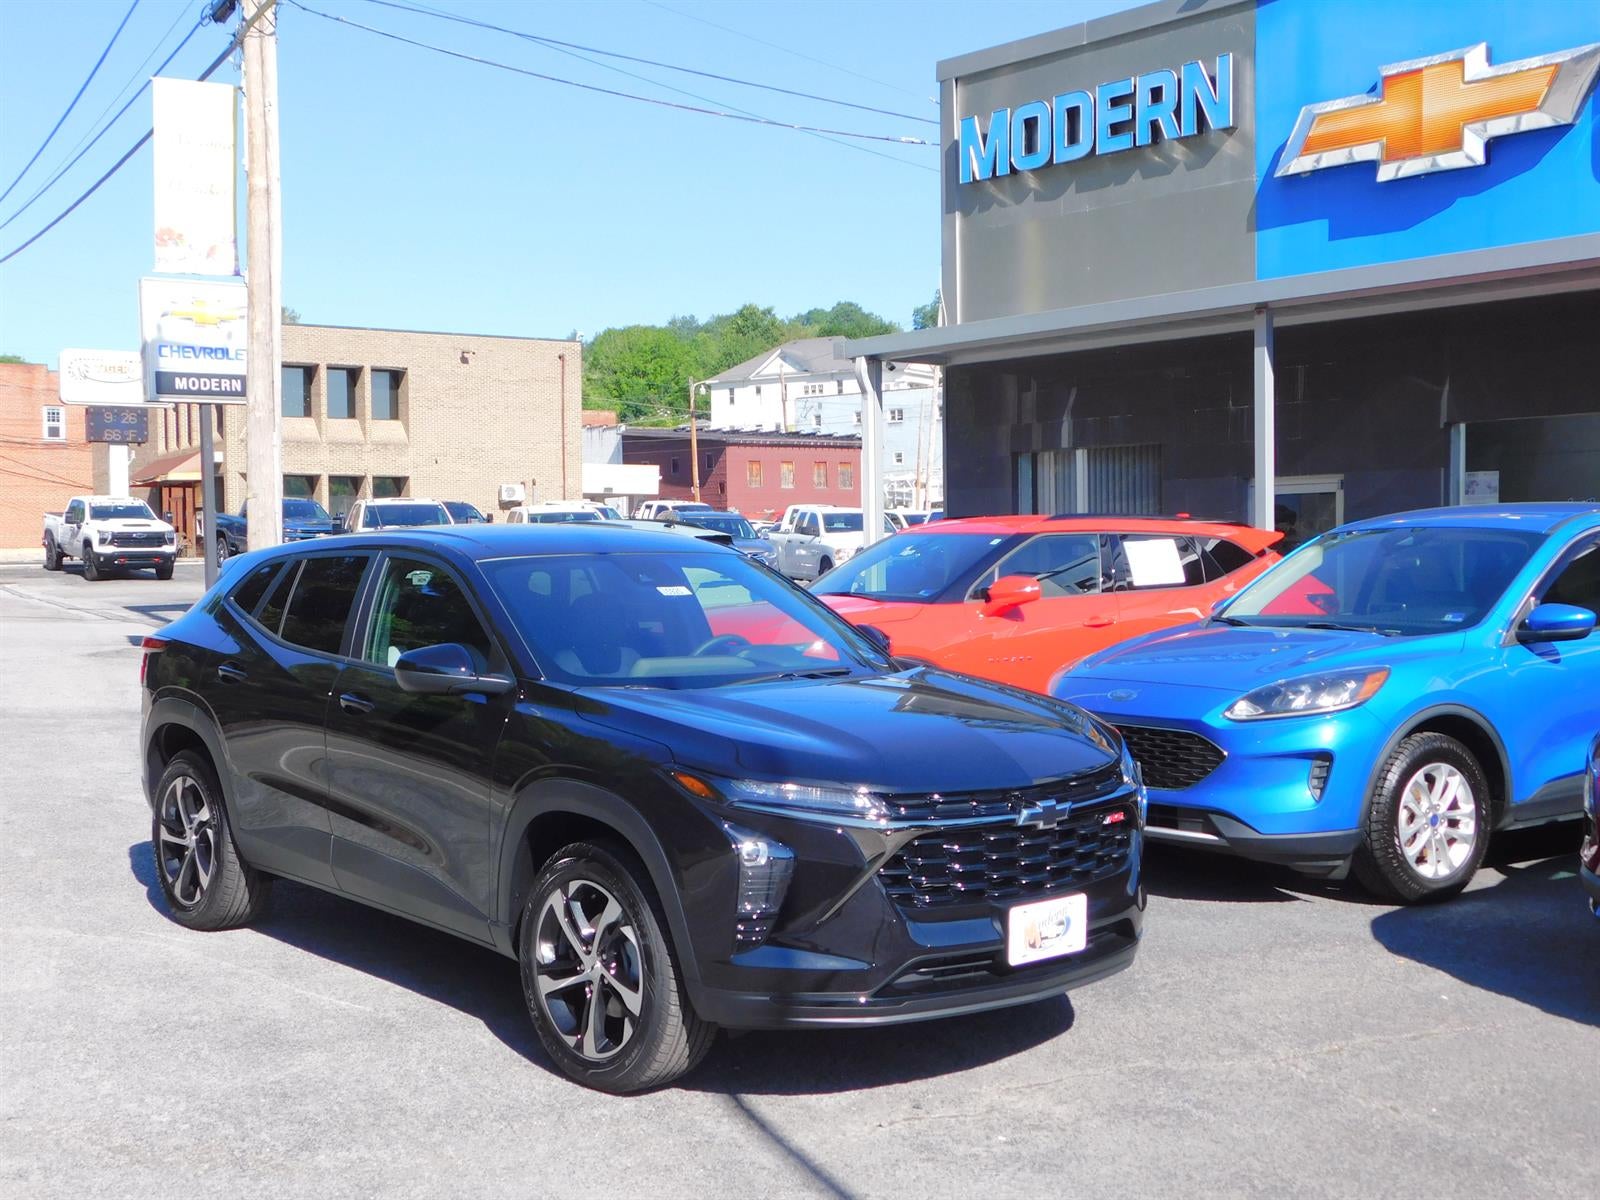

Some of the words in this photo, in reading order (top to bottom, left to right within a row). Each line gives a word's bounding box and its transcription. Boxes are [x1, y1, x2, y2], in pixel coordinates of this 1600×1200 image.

[960, 52, 1233, 184] MODERN
[158, 344, 247, 360] CHEVROLE
[174, 377, 242, 391] MODERN
